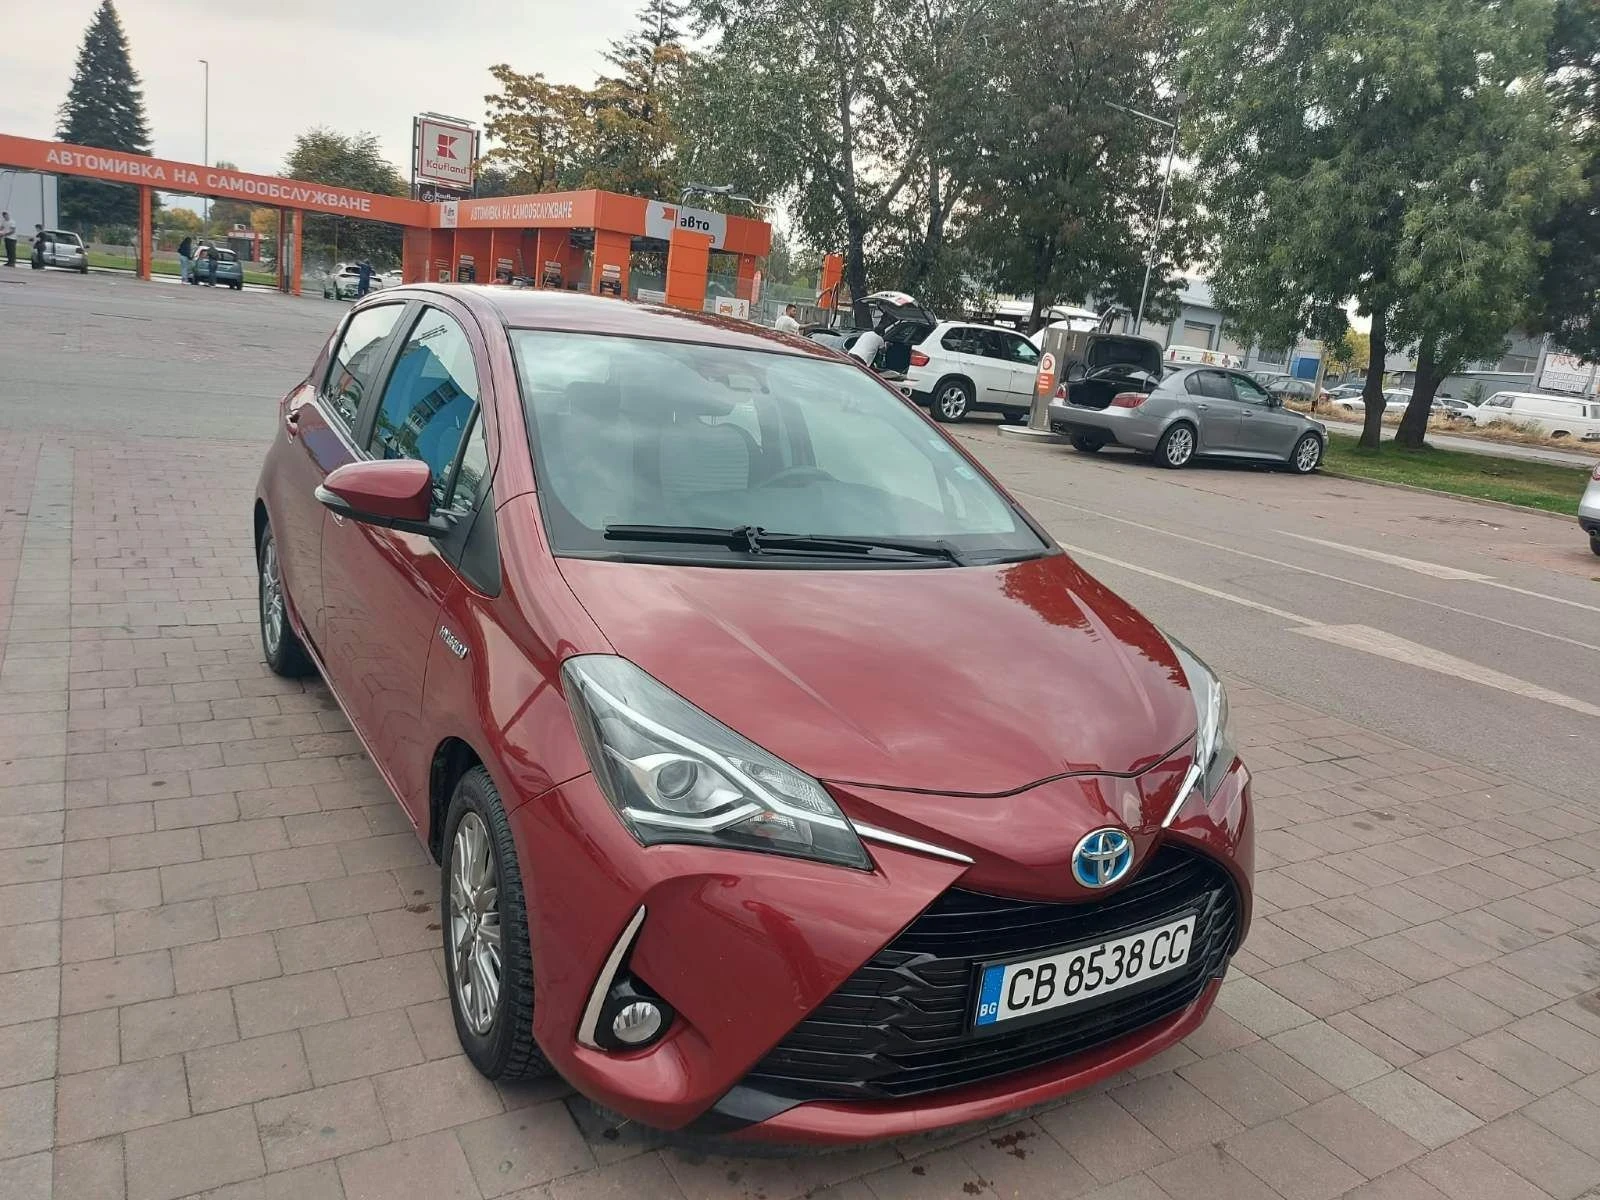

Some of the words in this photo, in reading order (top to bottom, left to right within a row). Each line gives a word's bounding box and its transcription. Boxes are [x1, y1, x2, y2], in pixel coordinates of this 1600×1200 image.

[426, 159, 466, 174] Kaufland
[46, 148, 165, 181] АВТОМИВКА
[174, 170, 200, 186] НА
[206, 174, 371, 212] САМООБСЛУЖВАНЕ
[502, 203, 510, 219] НА
[512, 201, 573, 218] САМООБСЛУЖВАНЕ
[680, 216, 709, 231] авто
[979, 1004, 997, 1017] BG
[1007, 962, 1057, 1011] CB
[1063, 939, 1145, 997] 8538
[1149, 924, 1188, 970] CC
